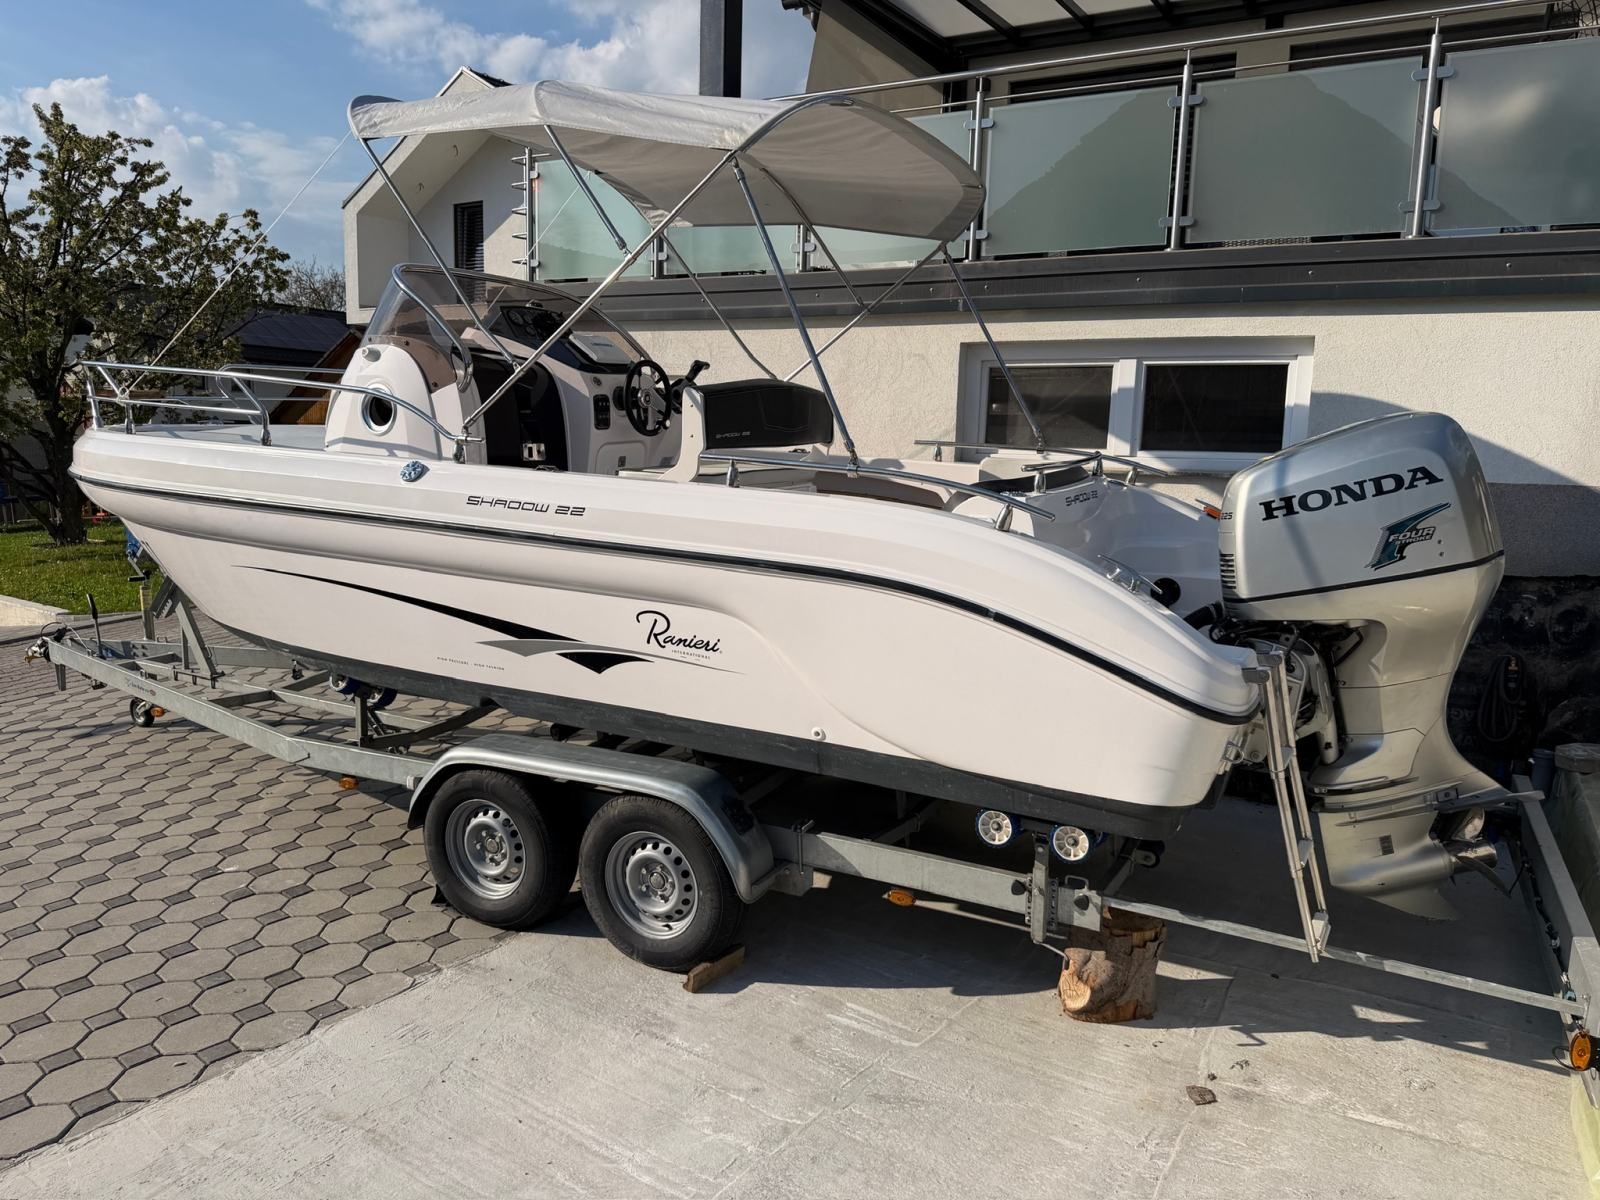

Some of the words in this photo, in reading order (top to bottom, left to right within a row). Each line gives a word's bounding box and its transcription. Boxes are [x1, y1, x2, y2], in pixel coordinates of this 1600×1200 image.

[1259, 466, 1444, 521] HONDA
[466, 495, 550, 513] SHADOW
[554, 505, 586, 516] 22
[1388, 527, 1436, 543] FOUR
[1395, 534, 1433, 545] STROKE
[636, 610, 721, 652] Ranieri
[671, 649, 711, 660] INTERNATIONAL
